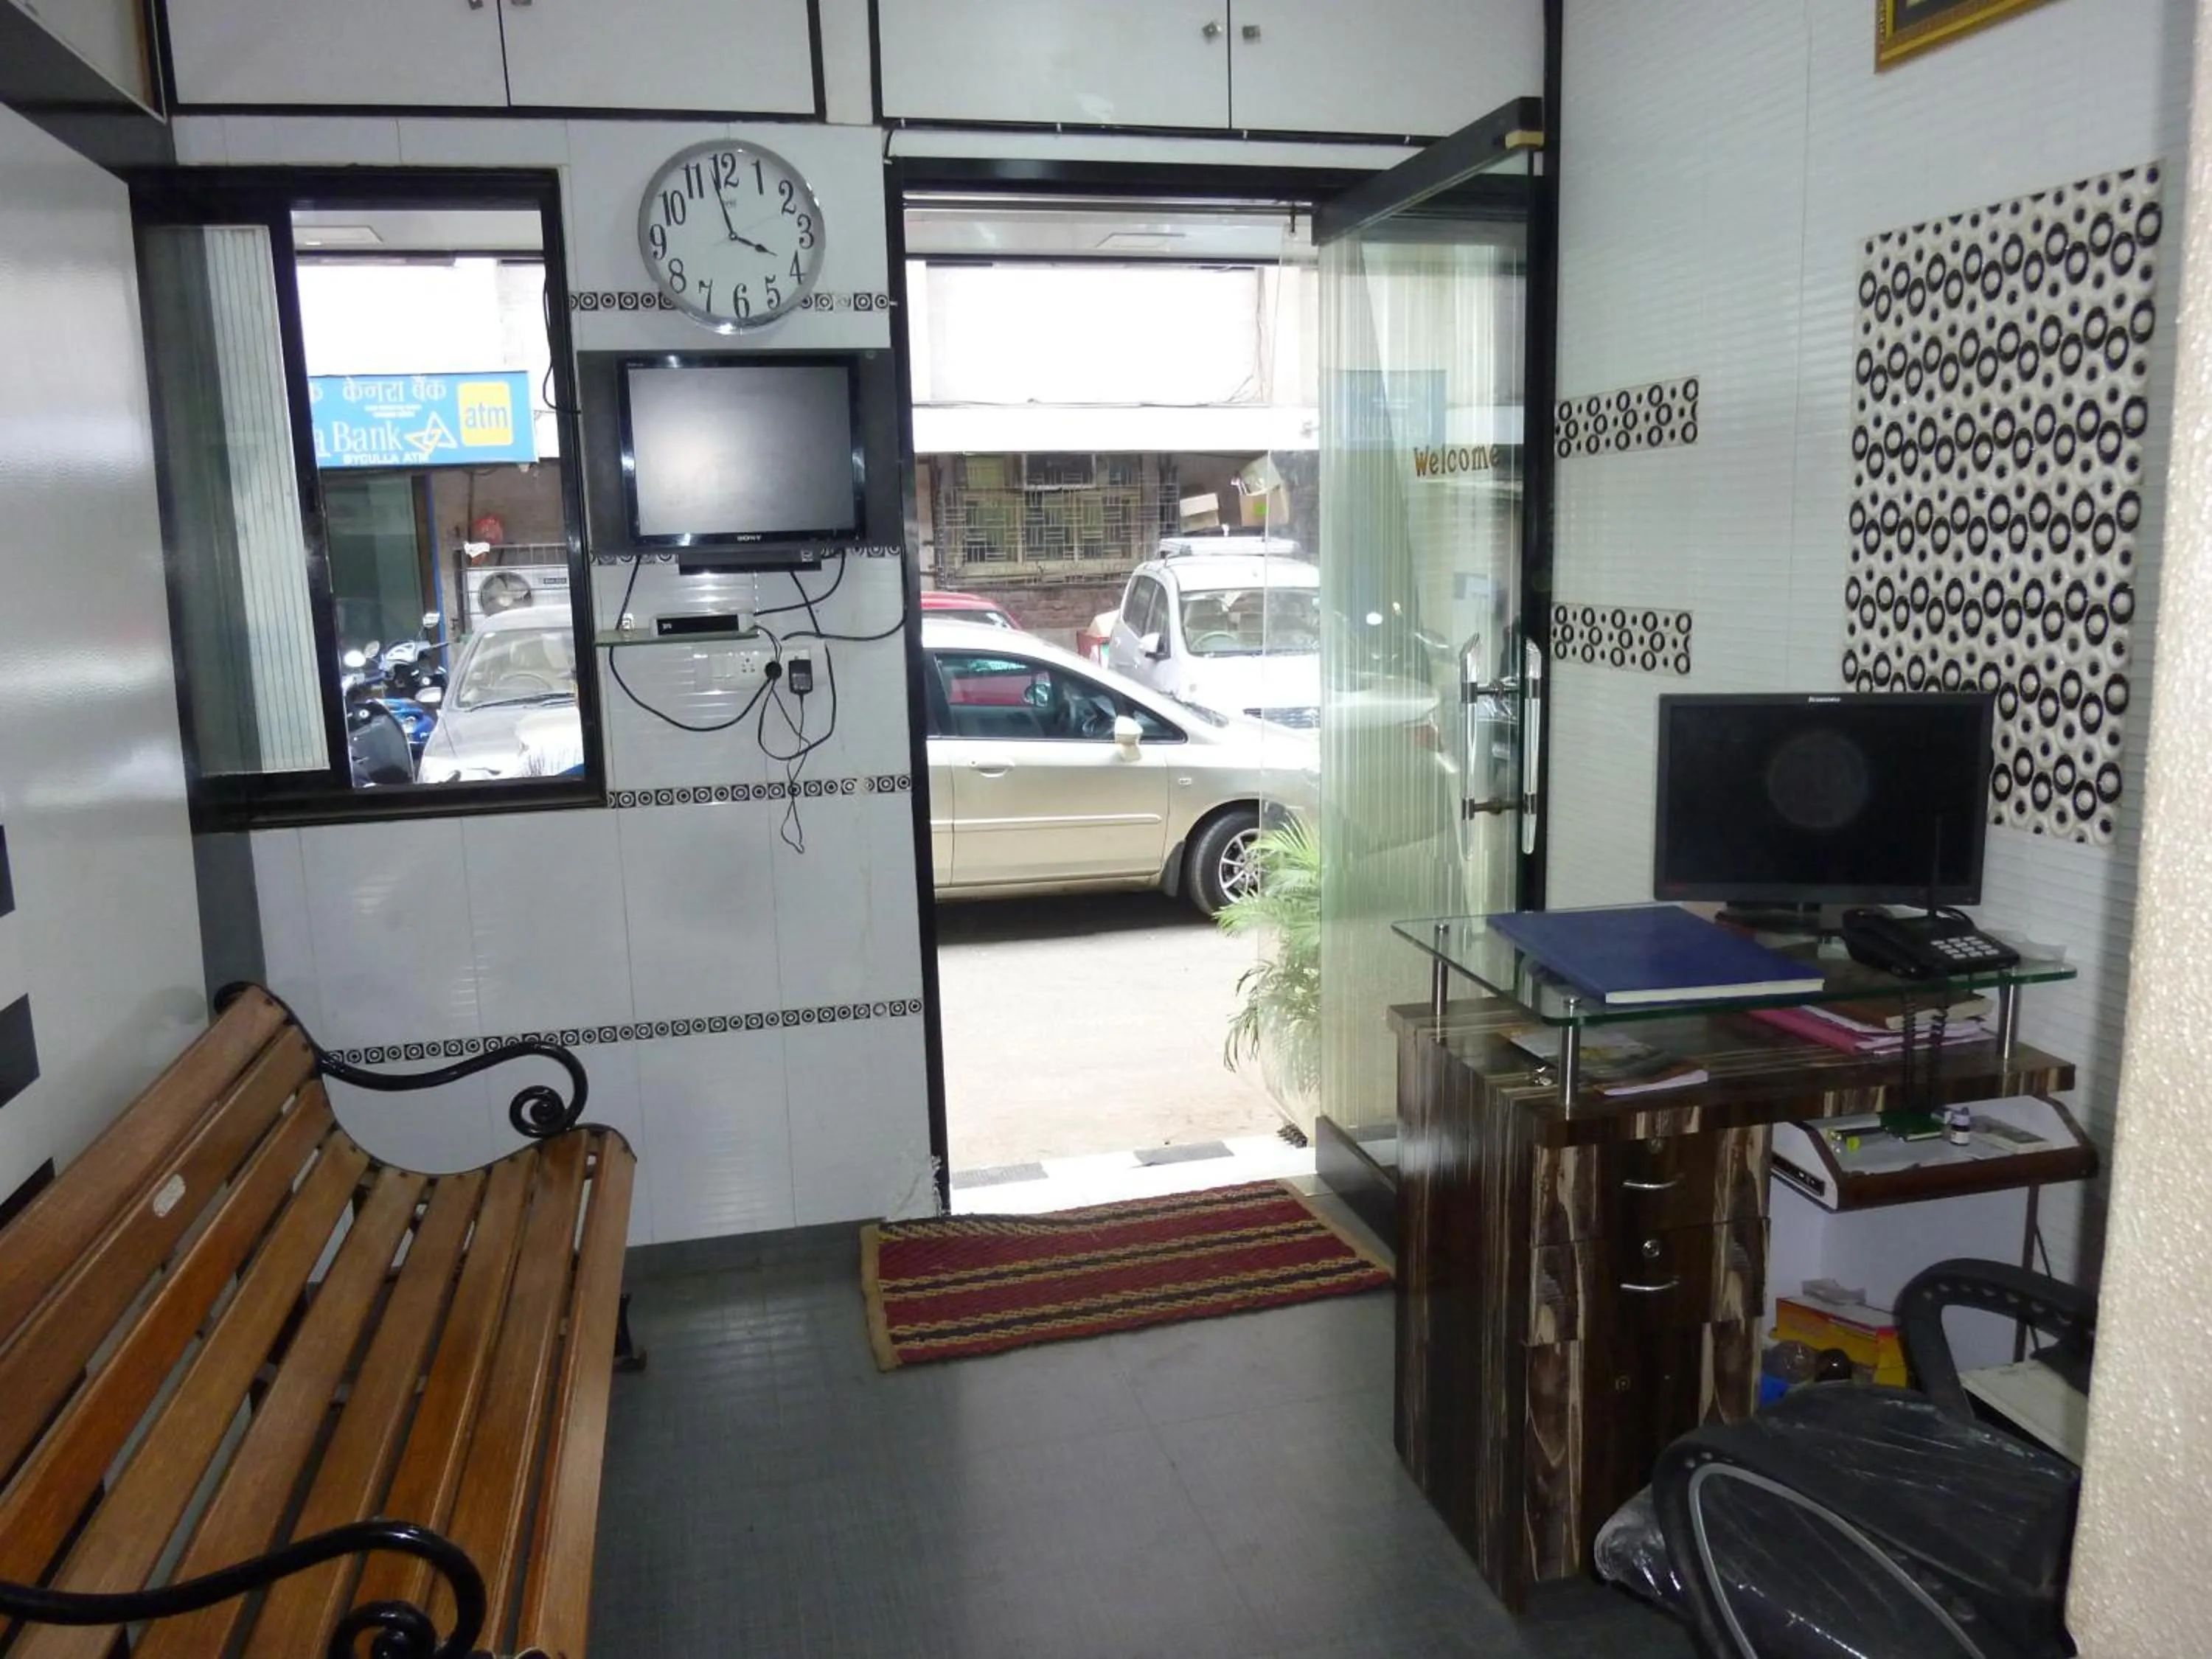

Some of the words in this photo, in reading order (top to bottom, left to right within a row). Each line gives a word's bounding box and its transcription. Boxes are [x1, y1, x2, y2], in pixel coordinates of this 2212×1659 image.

[681, 162, 704, 199] 11
[709, 153, 739, 189] 12
[751, 159, 764, 195] 1
[658, 189, 686, 226] 10
[778, 179, 796, 215] 2
[650, 223, 667, 260] 9
[797, 213, 814, 249] 3
[668, 258, 686, 293] 8
[790, 250, 807, 285] 4
[698, 279, 713, 313] 7
[733, 283, 750, 319] 6
[765, 274, 780, 310] 5
[465, 402, 509, 429] atm
[332, 420, 404, 453] Bank
[1413, 444, 1500, 477] Welcome
